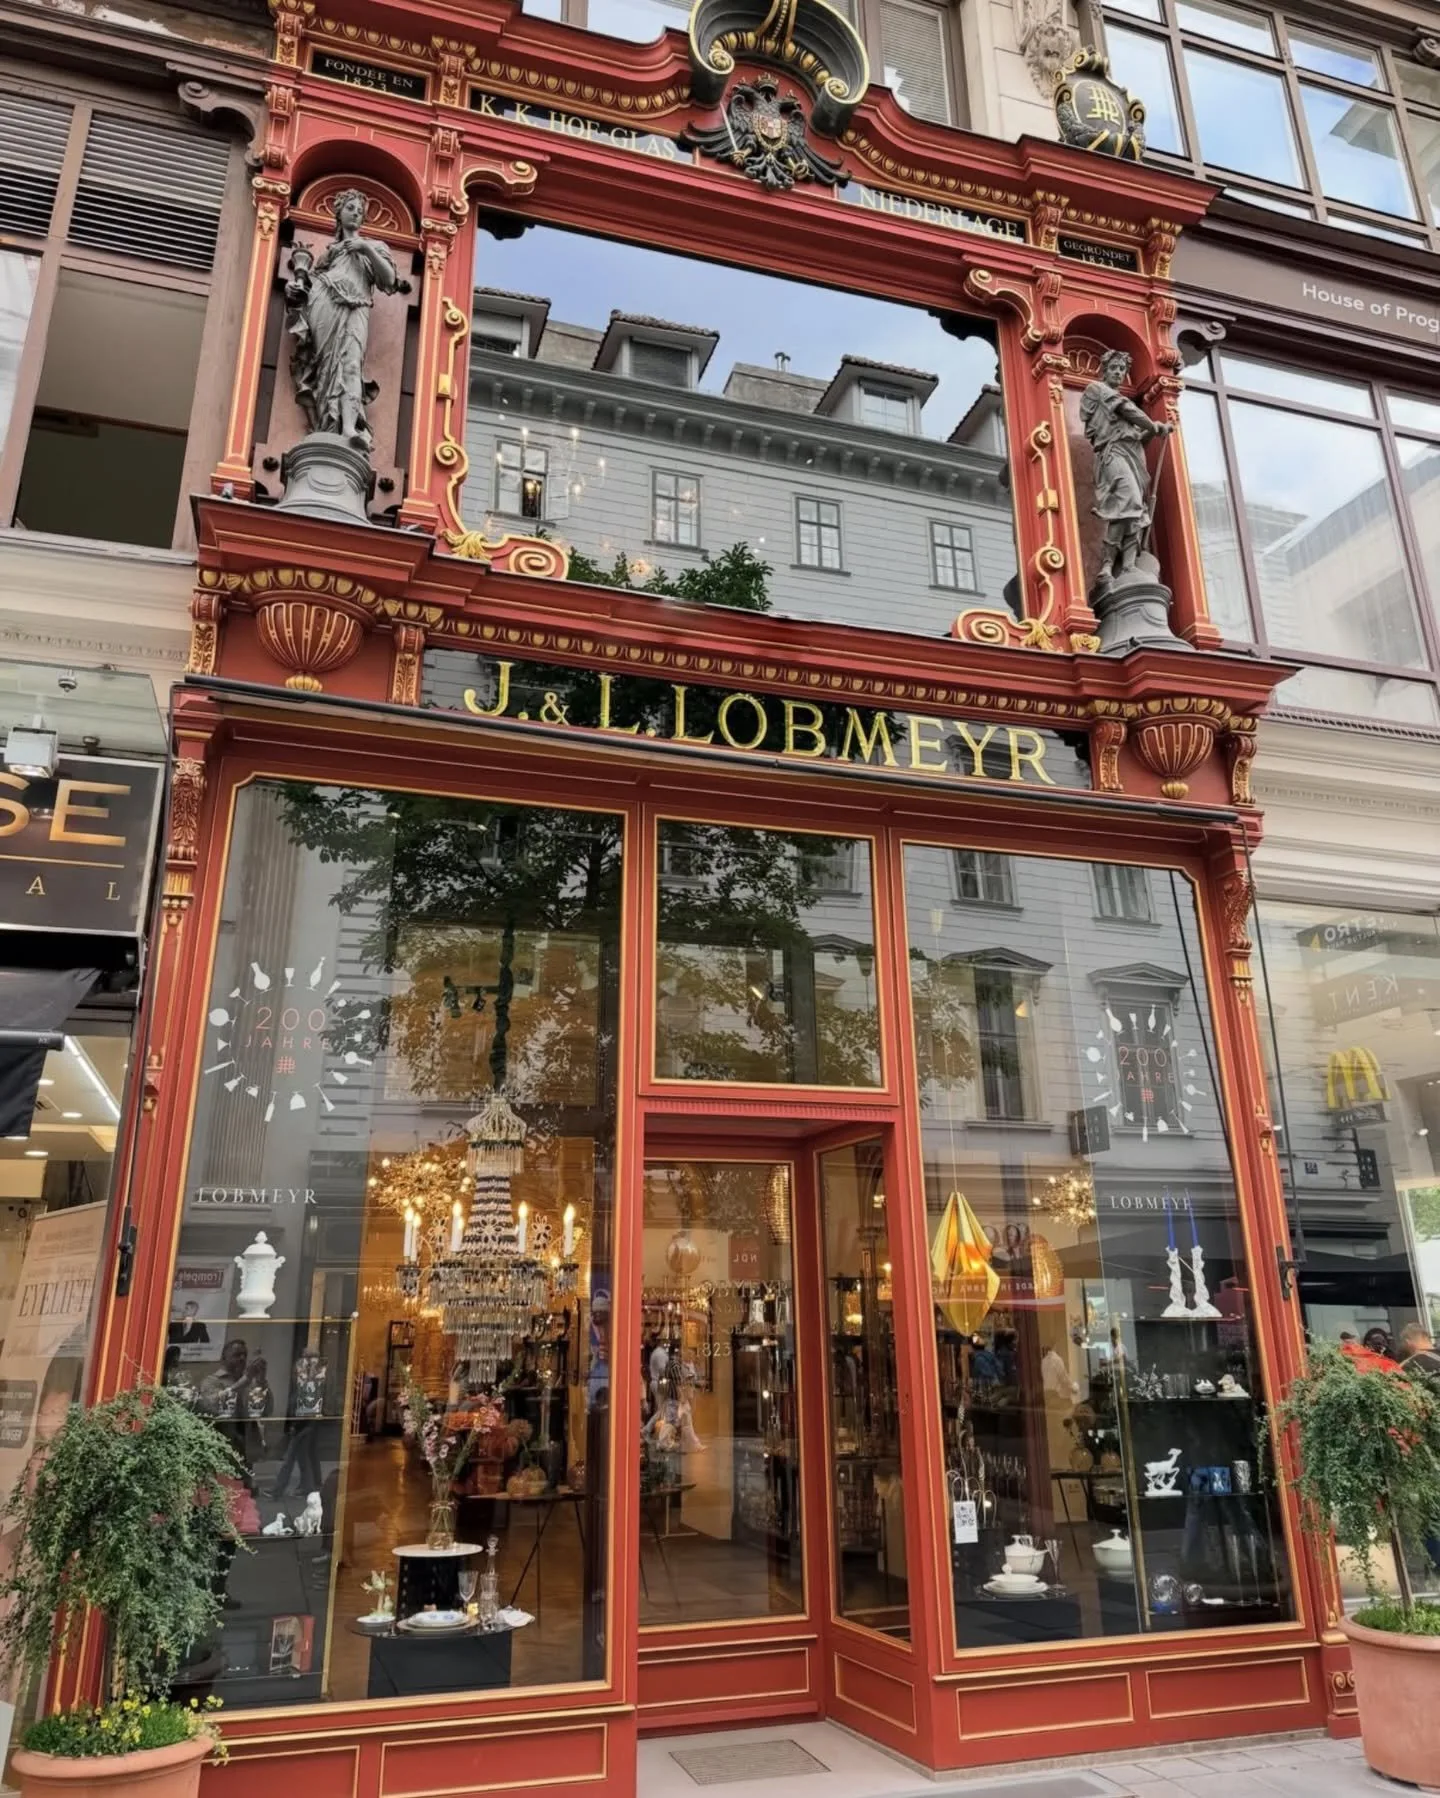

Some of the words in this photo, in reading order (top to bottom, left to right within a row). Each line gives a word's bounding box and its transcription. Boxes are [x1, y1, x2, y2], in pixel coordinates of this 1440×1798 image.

[343, 74, 387, 92] 1823
[393, 76, 414, 89] EN
[480, 94, 504, 117] K.
[515, 103, 538, 127] K.
[859, 187, 1019, 240] NIEDERLAGE
[1082, 253, 1114, 267] 1823
[1302, 282, 1365, 311] House
[1370, 302, 1391, 317] of
[1396, 305, 1440, 333] Prog
[464, 661, 529, 721] J.
[540, 692, 570, 726] &
[672, 684, 1057, 785] LOBMEYR
[255, 1006, 326, 1031] 200
[245, 1036, 330, 1050] JAHRE
[1118, 1046, 1168, 1068] 200
[198, 1187, 317, 1205] LOBMEYR
